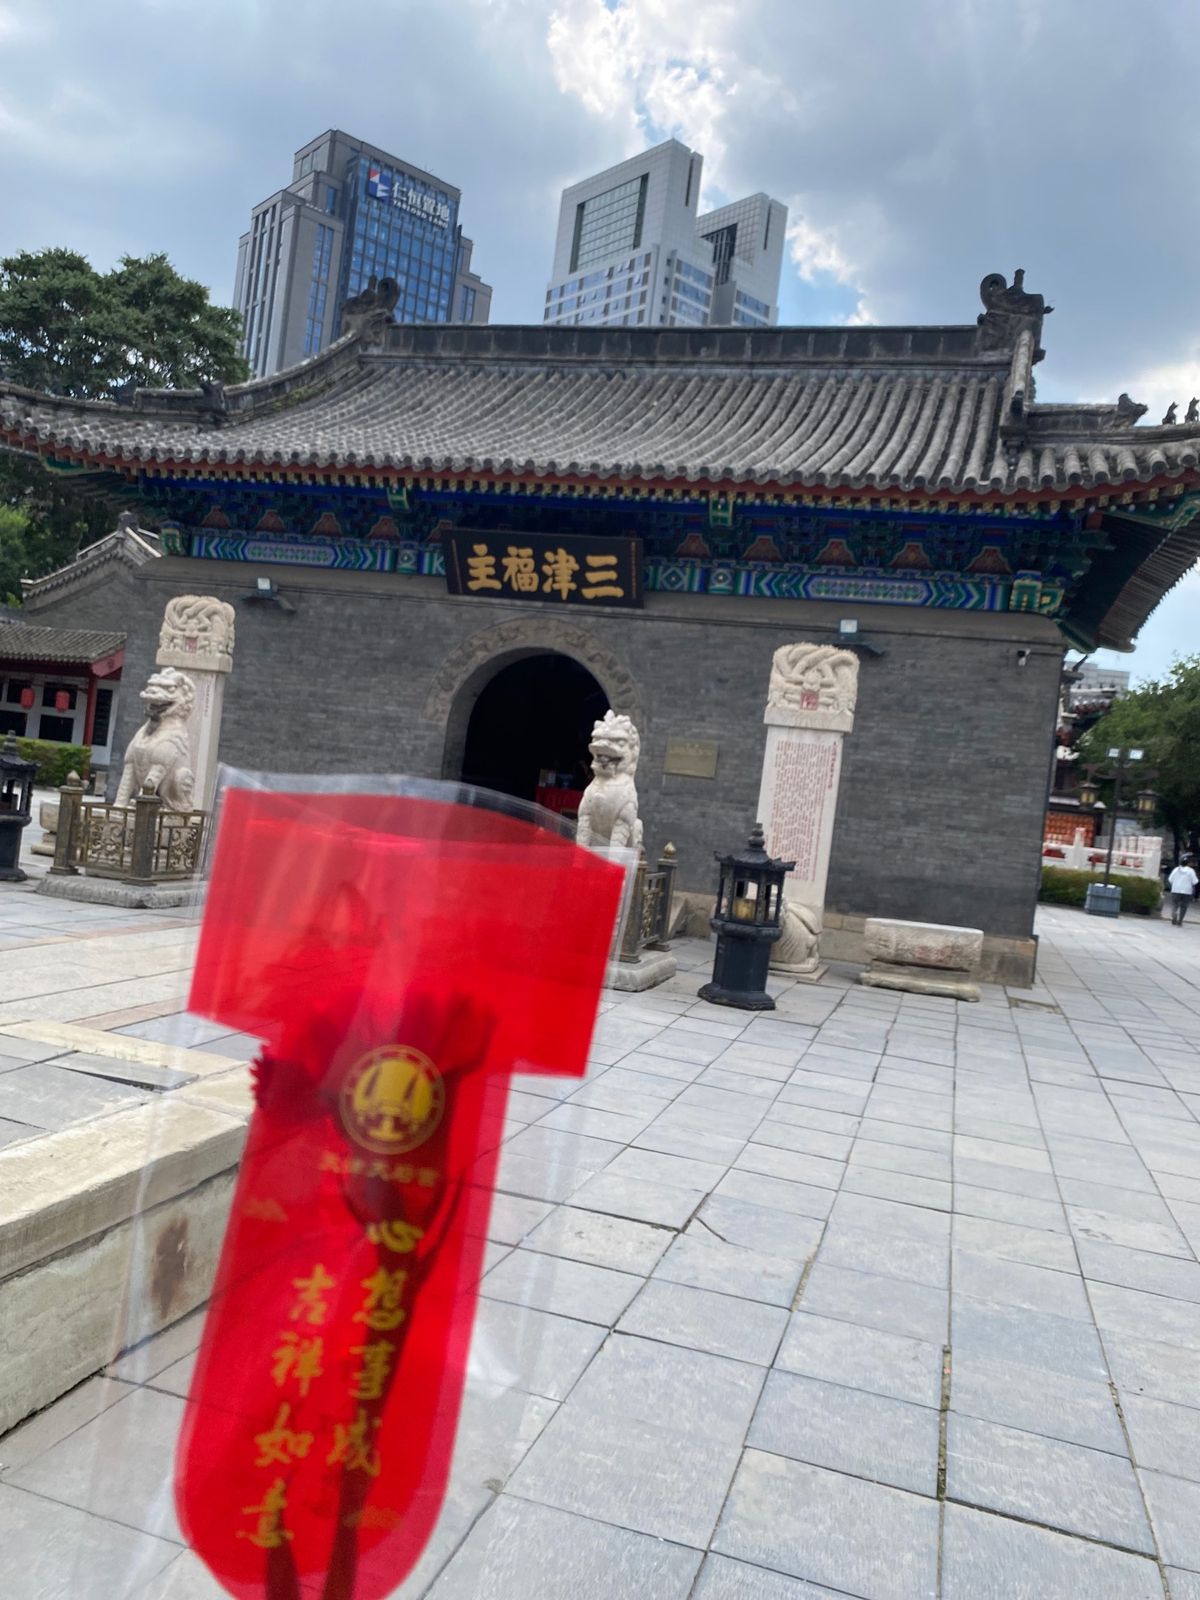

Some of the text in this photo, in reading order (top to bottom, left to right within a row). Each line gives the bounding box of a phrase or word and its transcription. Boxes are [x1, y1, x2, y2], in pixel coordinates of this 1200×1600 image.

[236, 1263, 336, 1549] 吉祥如意
[326, 1220, 424, 1477] 心想事成
